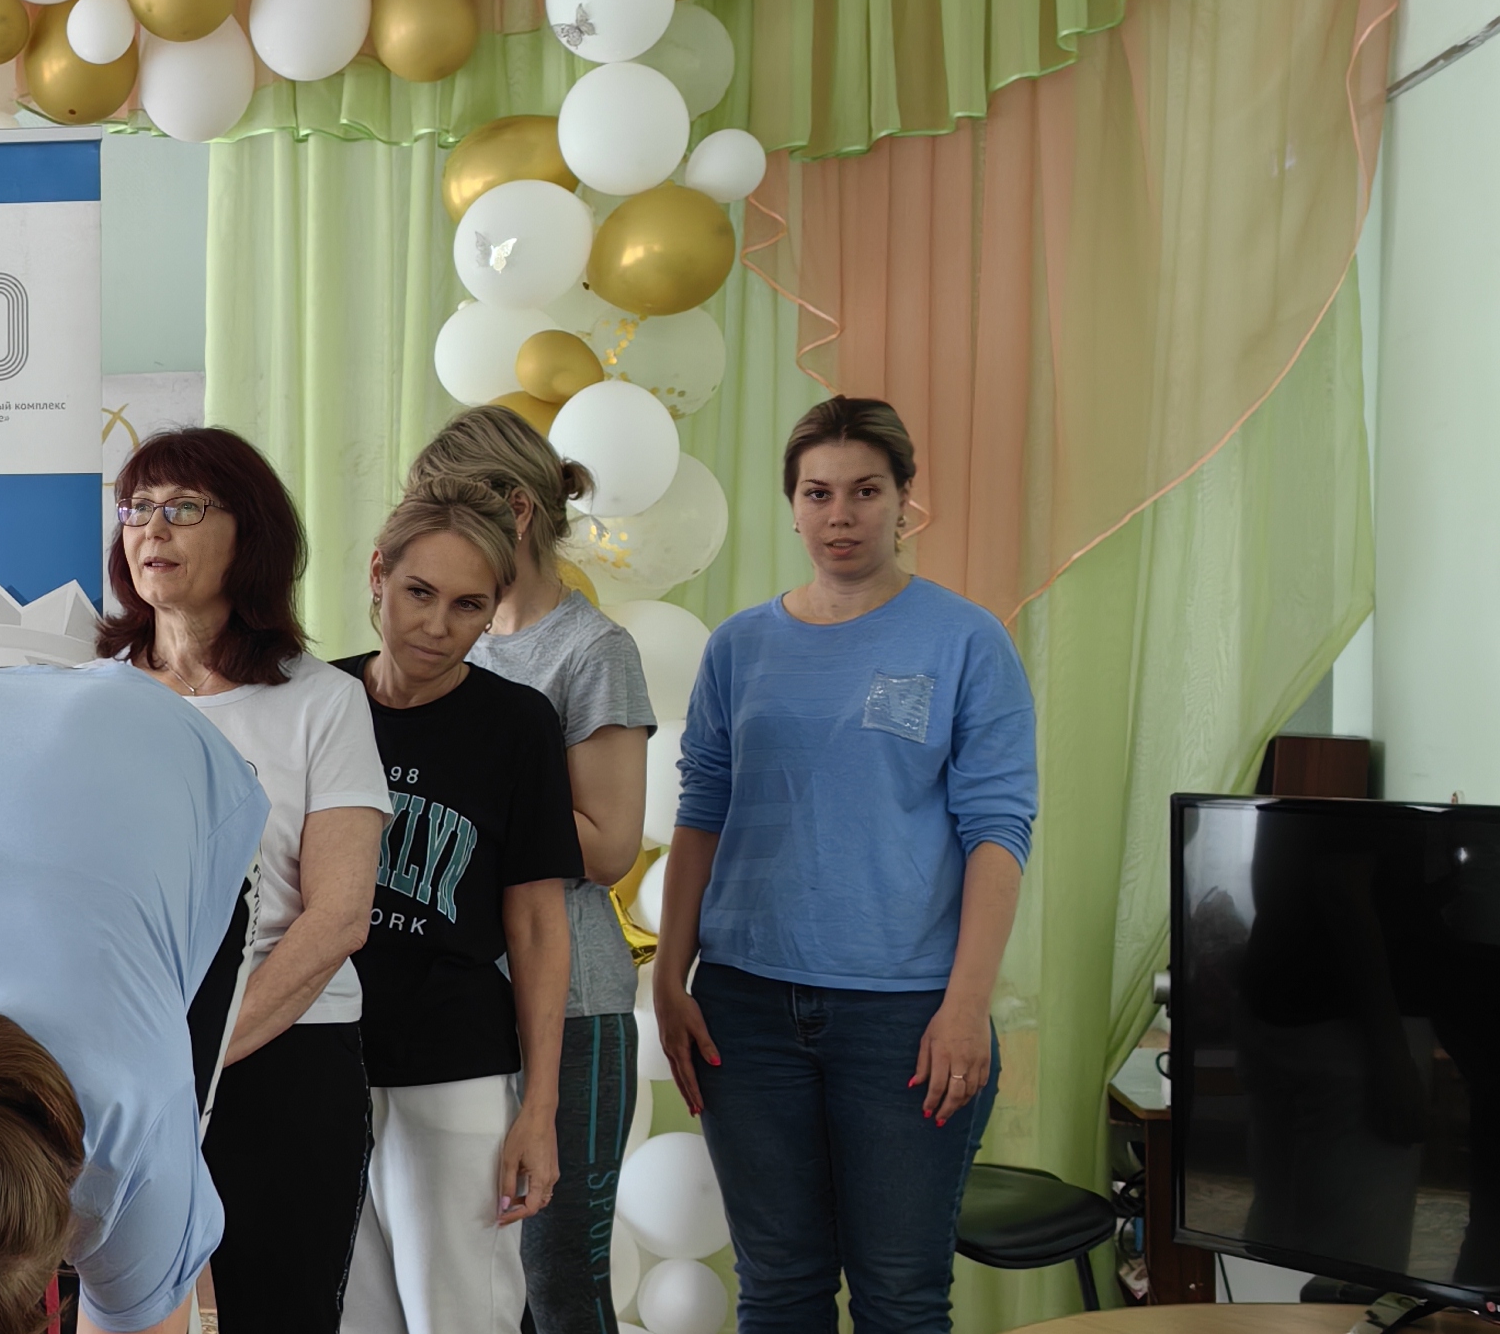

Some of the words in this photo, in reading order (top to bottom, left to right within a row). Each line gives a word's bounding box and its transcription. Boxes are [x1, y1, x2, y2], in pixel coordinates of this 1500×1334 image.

[14, 401, 66, 410] комплекс
[389, 766, 420, 784] 98
[377, 789, 478, 925] KLYN
[369, 908, 427, 936] ORK
